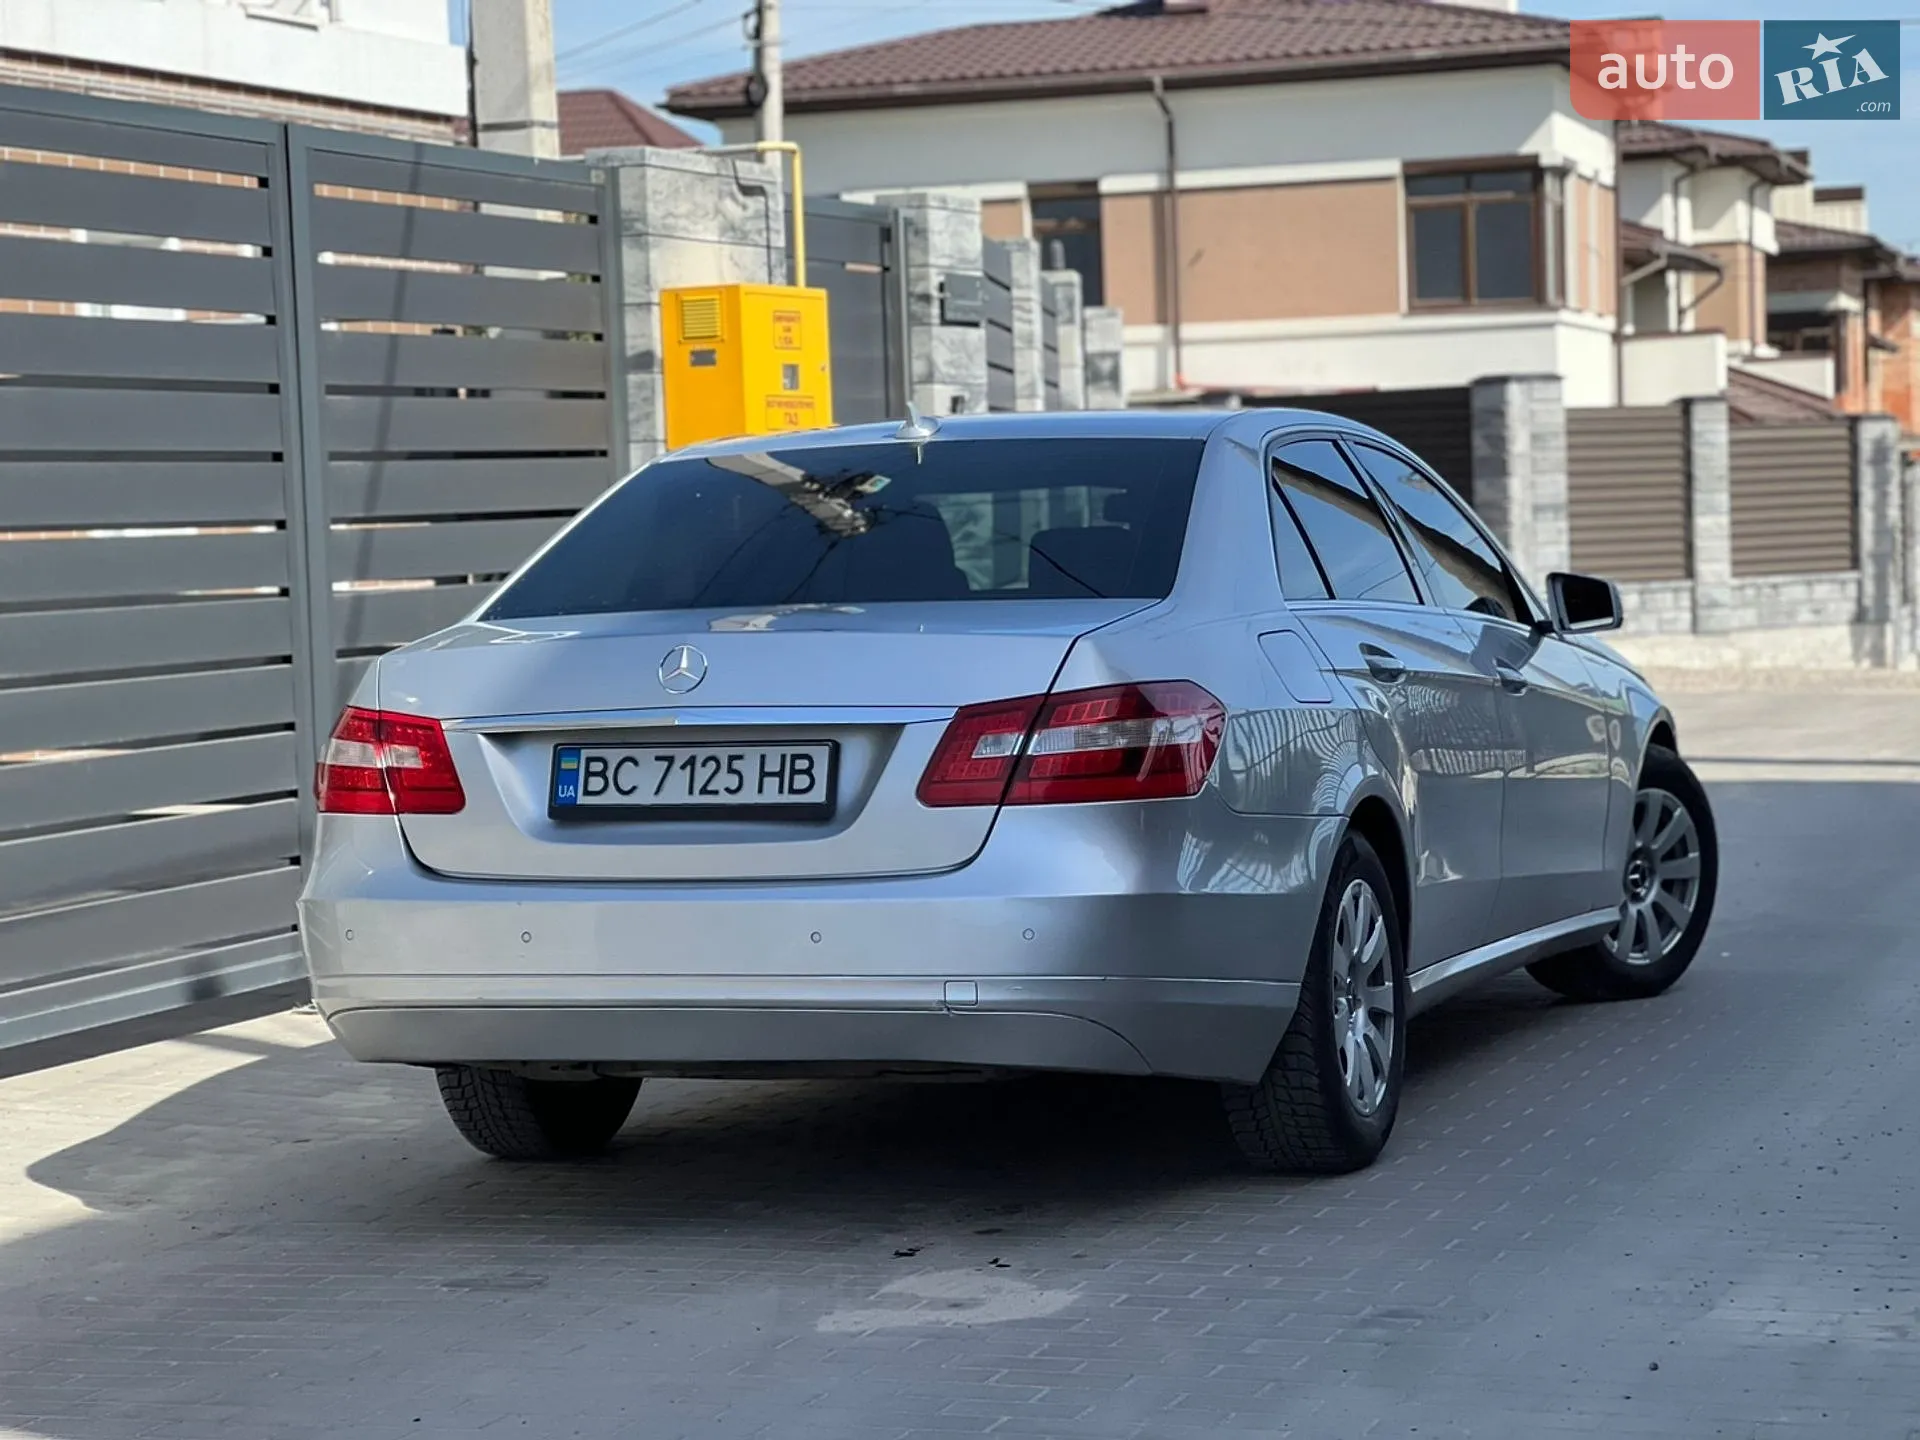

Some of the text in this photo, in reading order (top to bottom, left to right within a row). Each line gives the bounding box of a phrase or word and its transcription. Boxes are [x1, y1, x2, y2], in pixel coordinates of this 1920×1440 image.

[582, 753, 816, 796] BC 7125 HB
[558, 785, 576, 798] UA
